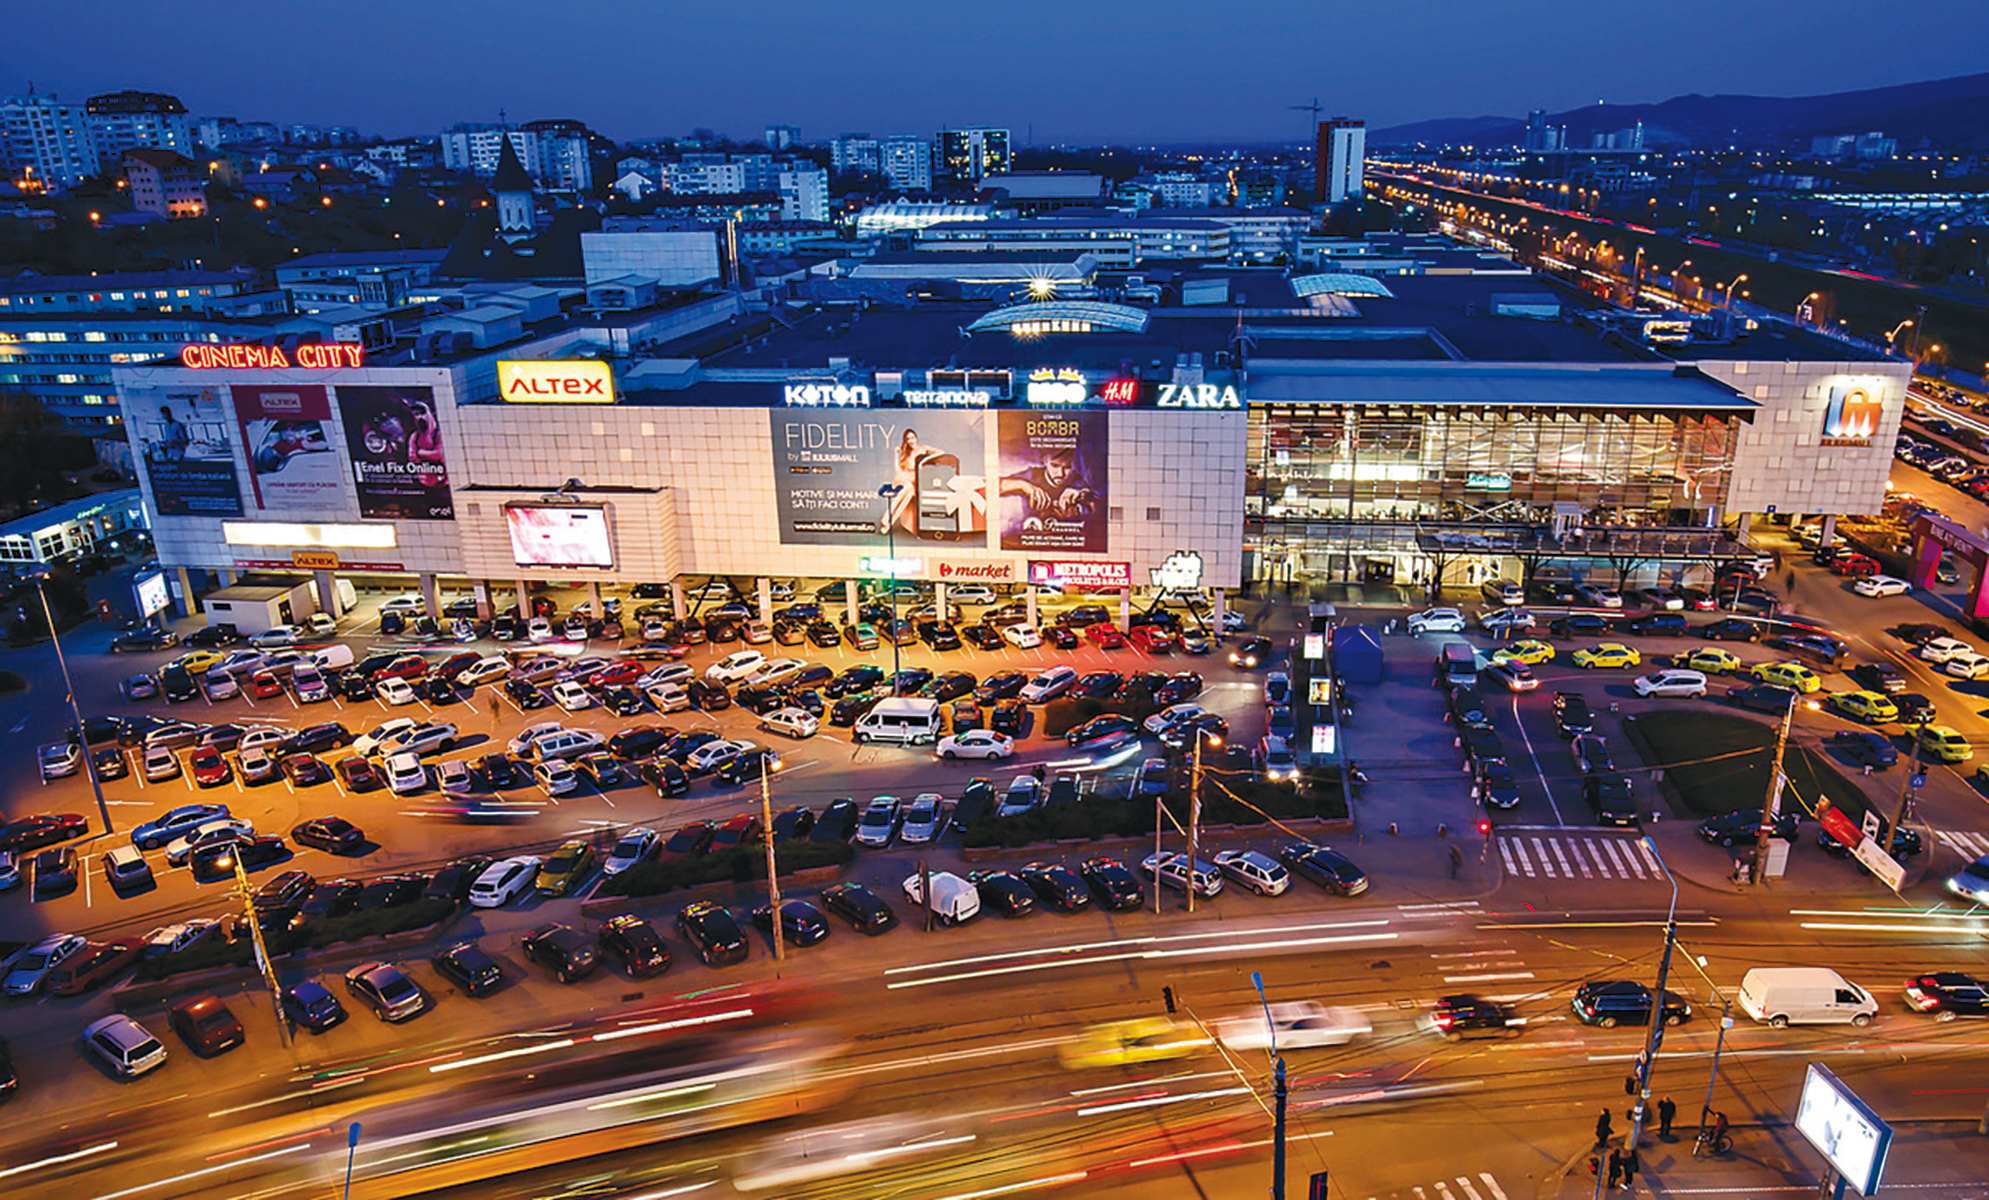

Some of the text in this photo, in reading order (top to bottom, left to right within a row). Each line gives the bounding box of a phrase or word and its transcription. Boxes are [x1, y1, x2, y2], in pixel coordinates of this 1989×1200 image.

[182, 345, 364, 368] CINEMA CITY
[1104, 382, 1135, 401] H&M
[1157, 384, 1241, 408] ZARA
[785, 423, 896, 449] FIDELITY
[787, 452, 799, 462] by
[361, 461, 445, 474] Enel Fix Online
[790, 490, 824, 499] MOTIVE
[836, 490, 854, 499] MAI
[955, 563, 1011, 579] market
[1053, 563, 1127, 577] METROPOLIS
